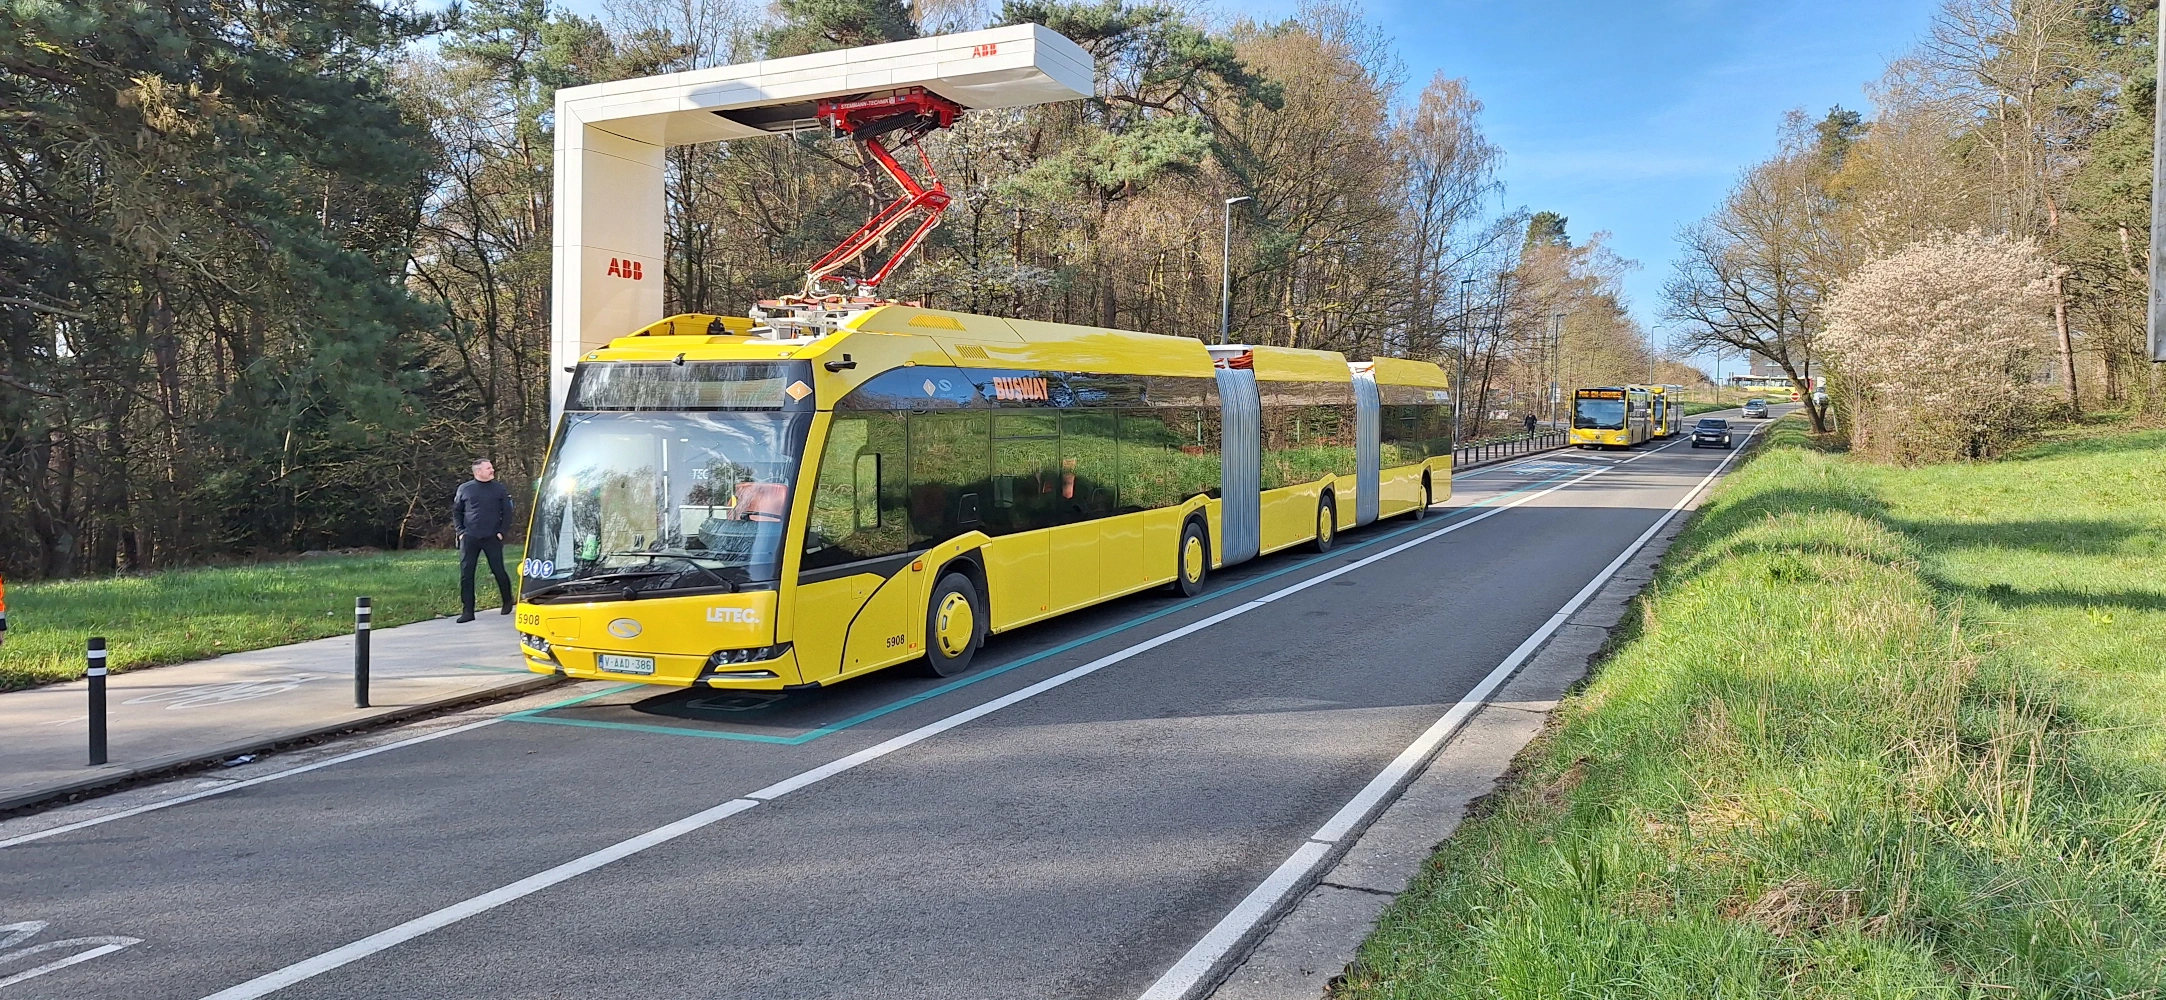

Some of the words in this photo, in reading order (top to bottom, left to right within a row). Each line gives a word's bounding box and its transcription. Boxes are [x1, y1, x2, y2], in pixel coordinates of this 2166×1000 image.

[972, 43, 997, 58] ABB
[607, 257, 642, 280] ABB
[993, 377, 1048, 400] BUSWAY
[692, 468, 708, 480] TEC
[518, 613, 540, 625] 5908
[886, 633, 905, 648] 5908
